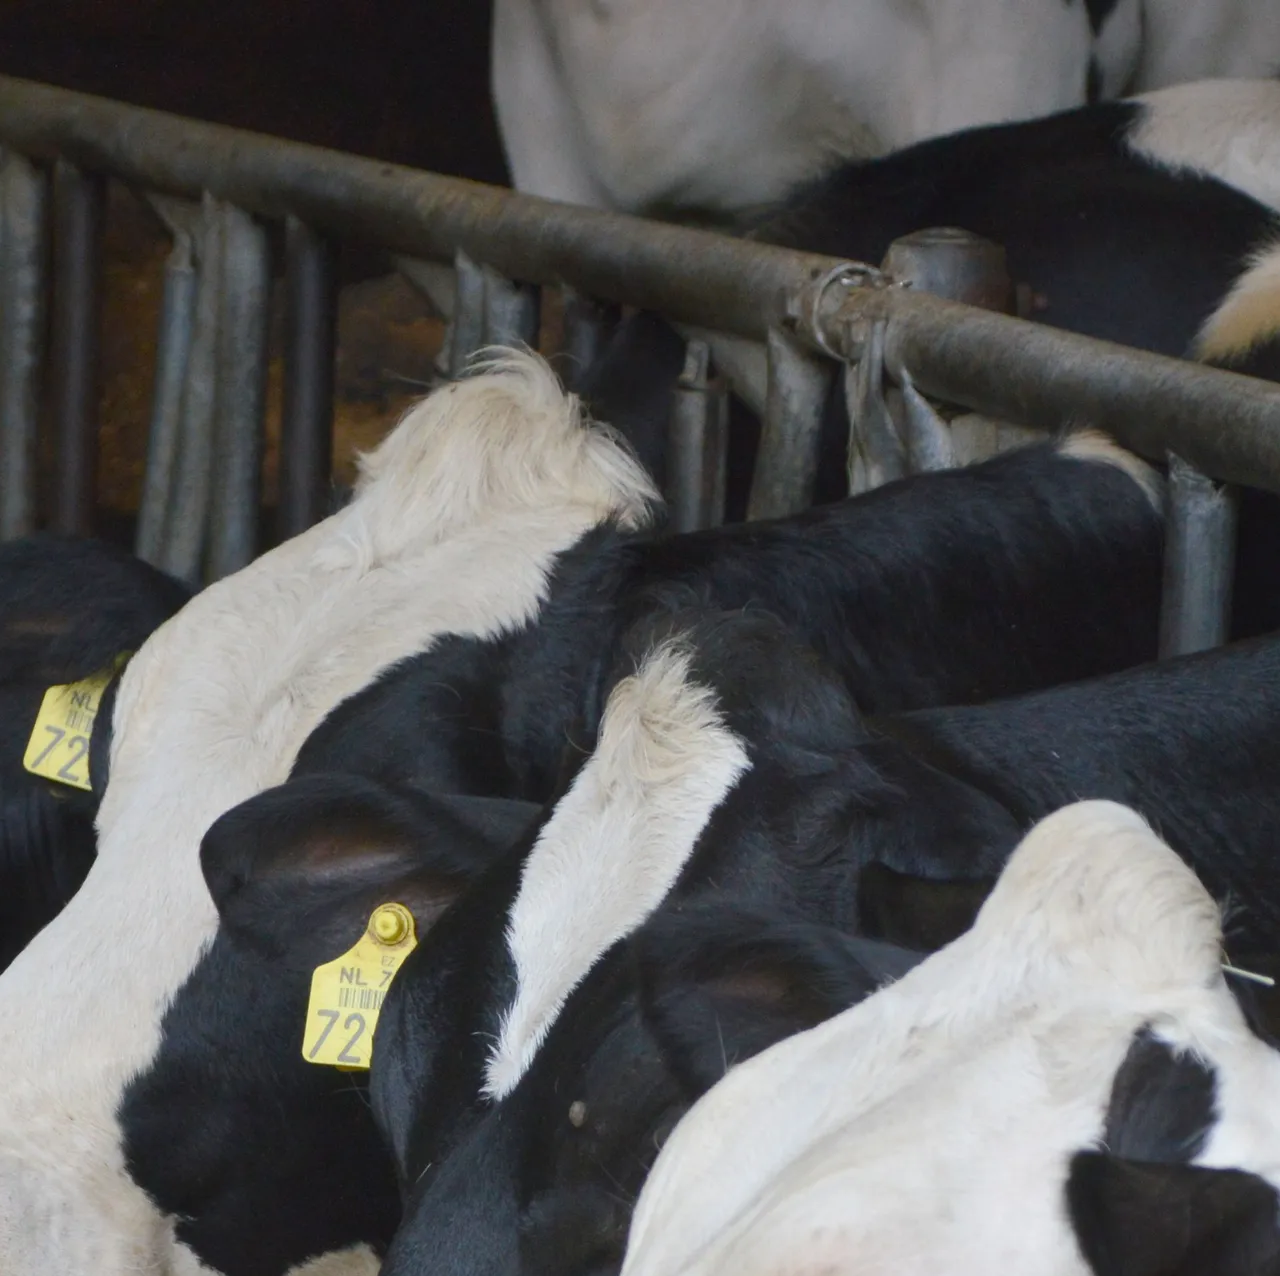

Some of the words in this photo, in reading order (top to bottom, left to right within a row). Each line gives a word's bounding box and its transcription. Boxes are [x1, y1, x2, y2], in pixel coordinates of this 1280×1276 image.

[70, 690, 97, 713] NL
[31, 723, 91, 786] 72
[339, 967, 367, 986] NL
[309, 1008, 367, 1064] 72
